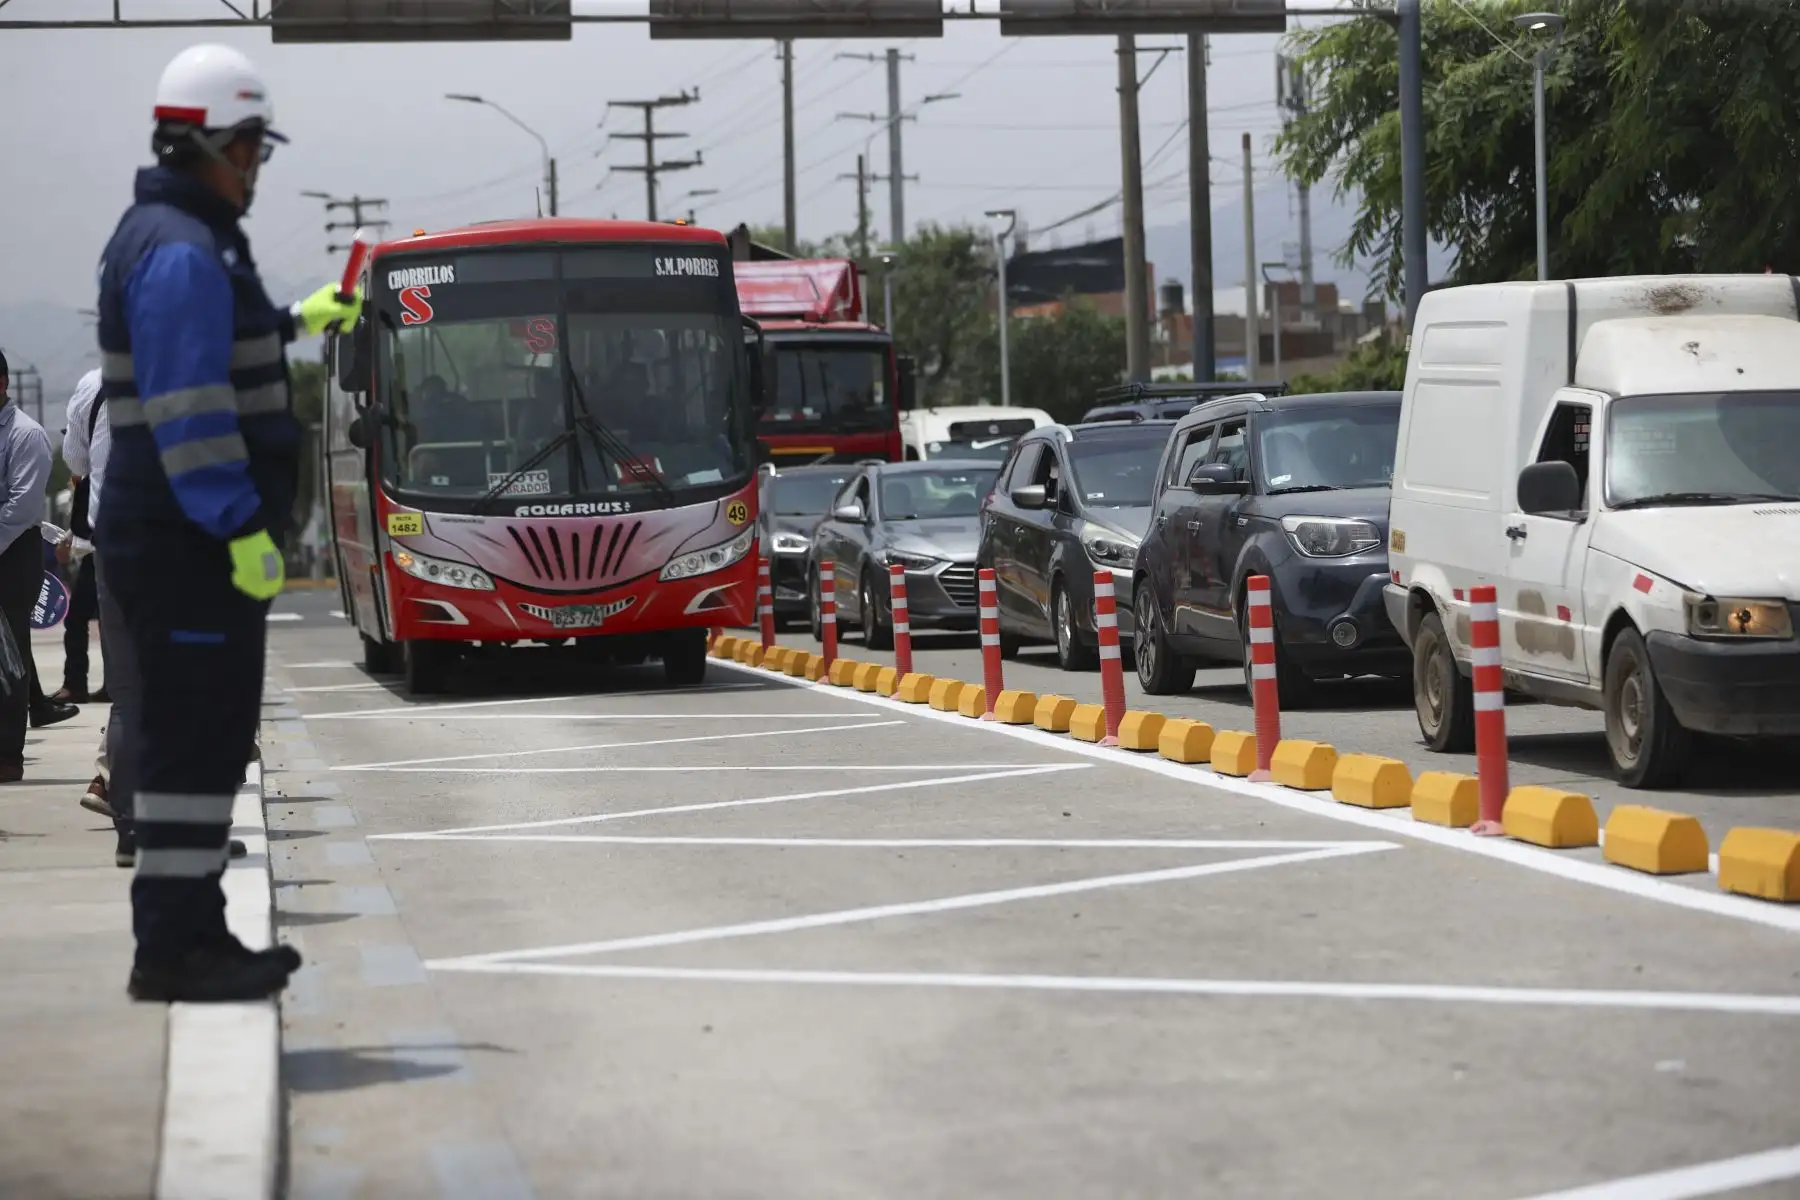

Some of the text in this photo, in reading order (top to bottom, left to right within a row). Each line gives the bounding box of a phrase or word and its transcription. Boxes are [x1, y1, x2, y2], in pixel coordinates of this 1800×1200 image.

[388, 265, 455, 290] CHORRILLOS
[399, 285, 433, 325] S
[527, 318, 555, 354] S
[515, 502, 623, 517] AQUARIUS
[728, 506, 746, 521] 49
[392, 523, 418, 533] 1482
